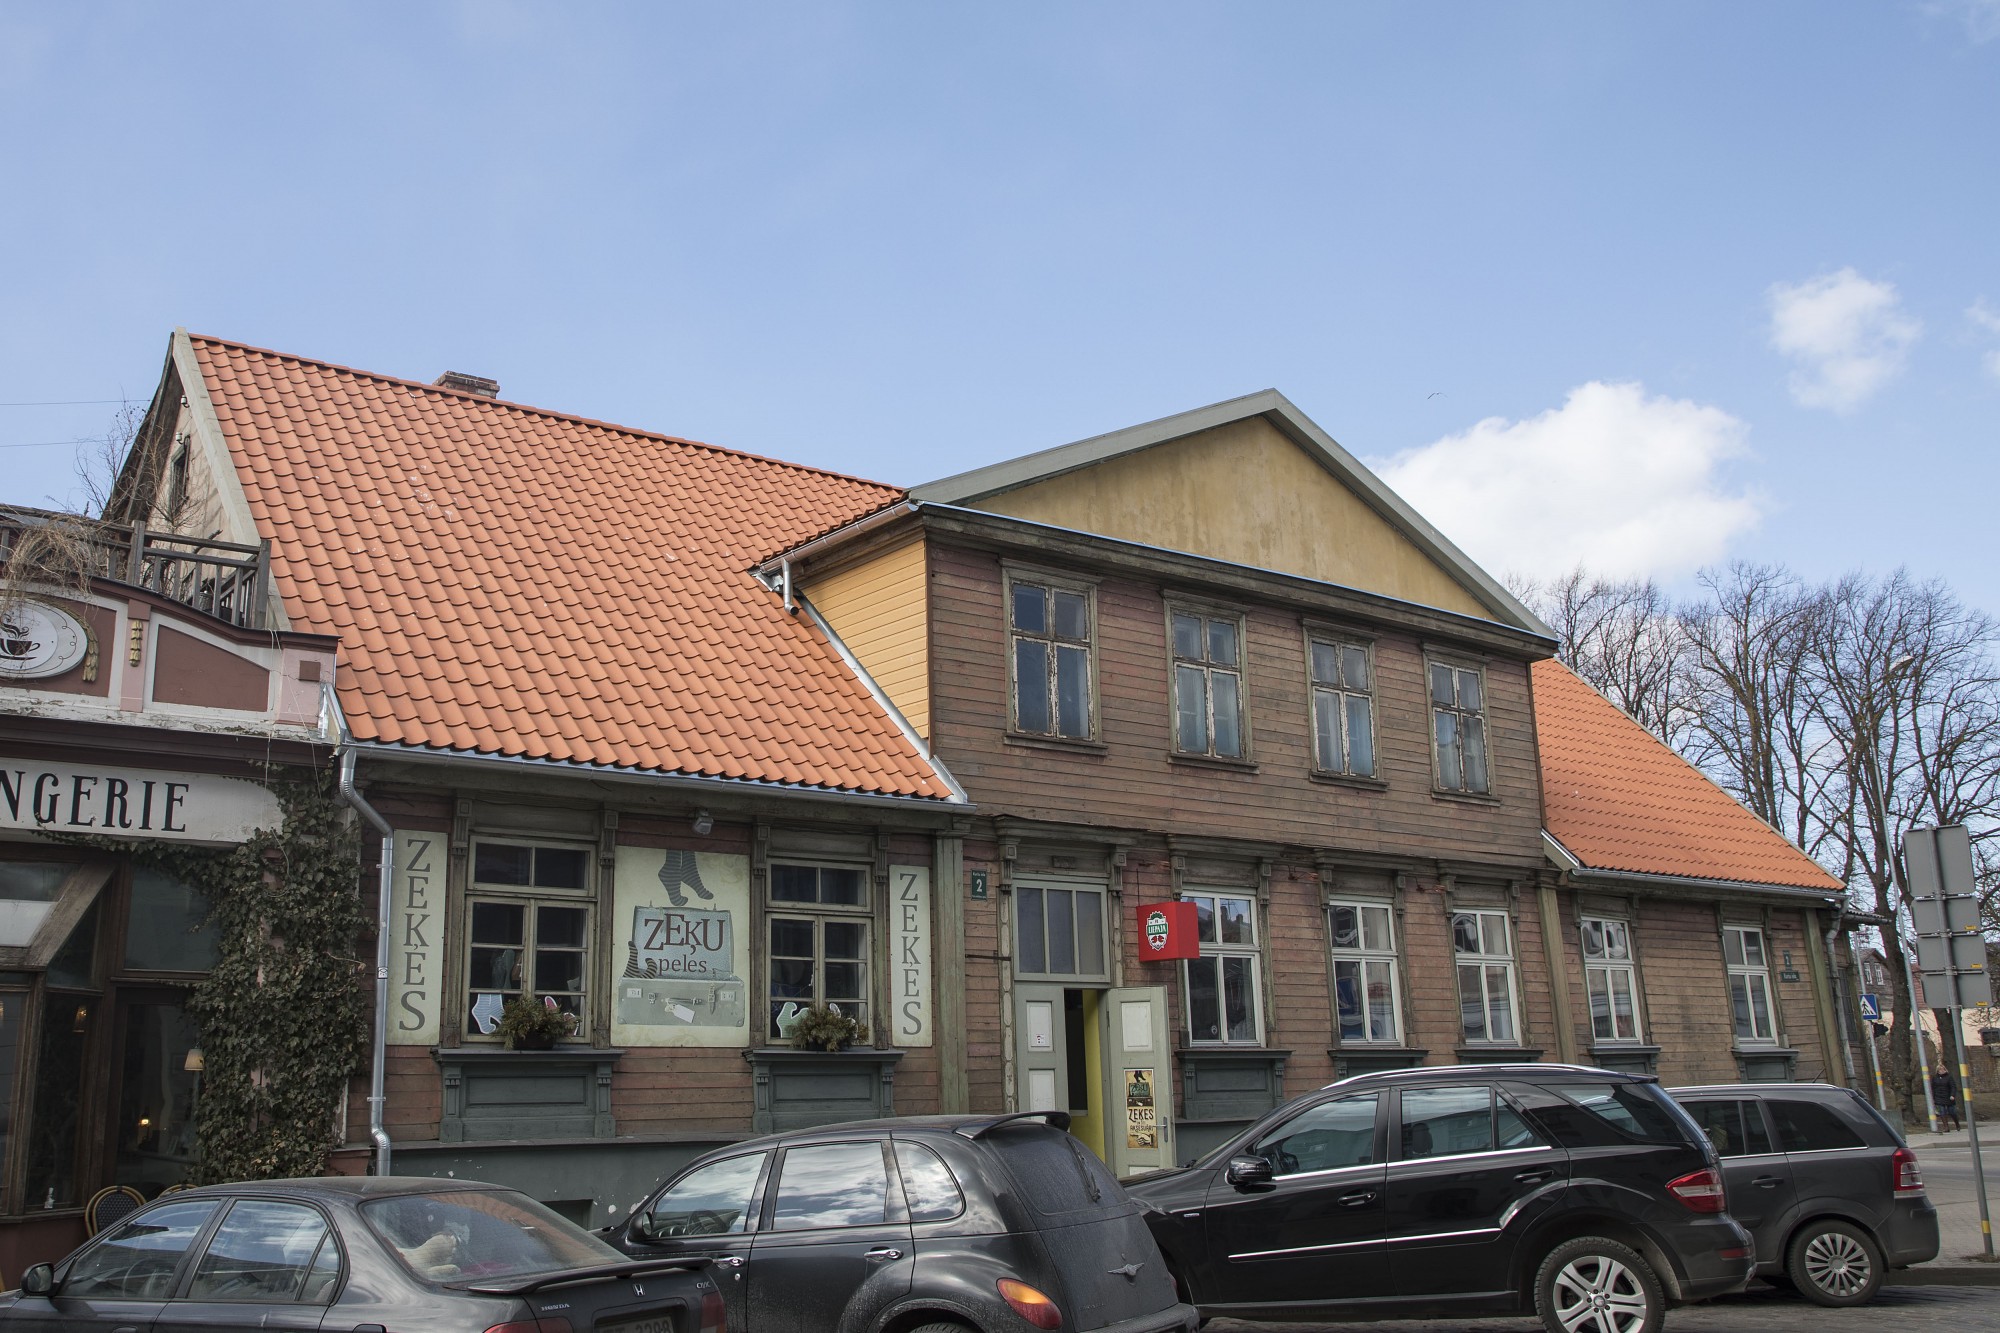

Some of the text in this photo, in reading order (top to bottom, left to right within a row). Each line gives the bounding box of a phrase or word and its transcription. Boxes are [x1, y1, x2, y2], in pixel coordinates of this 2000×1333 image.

[0, 770, 189, 832] NGERIE
[976, 879, 982, 892] 2
[399, 839, 431, 1031] ZEĶES
[644, 913, 725, 955] ZEĶU
[900, 873, 922, 1036] ZEĶES
[658, 954, 707, 976] peles
[541, 1303, 570, 1311] HONDA
